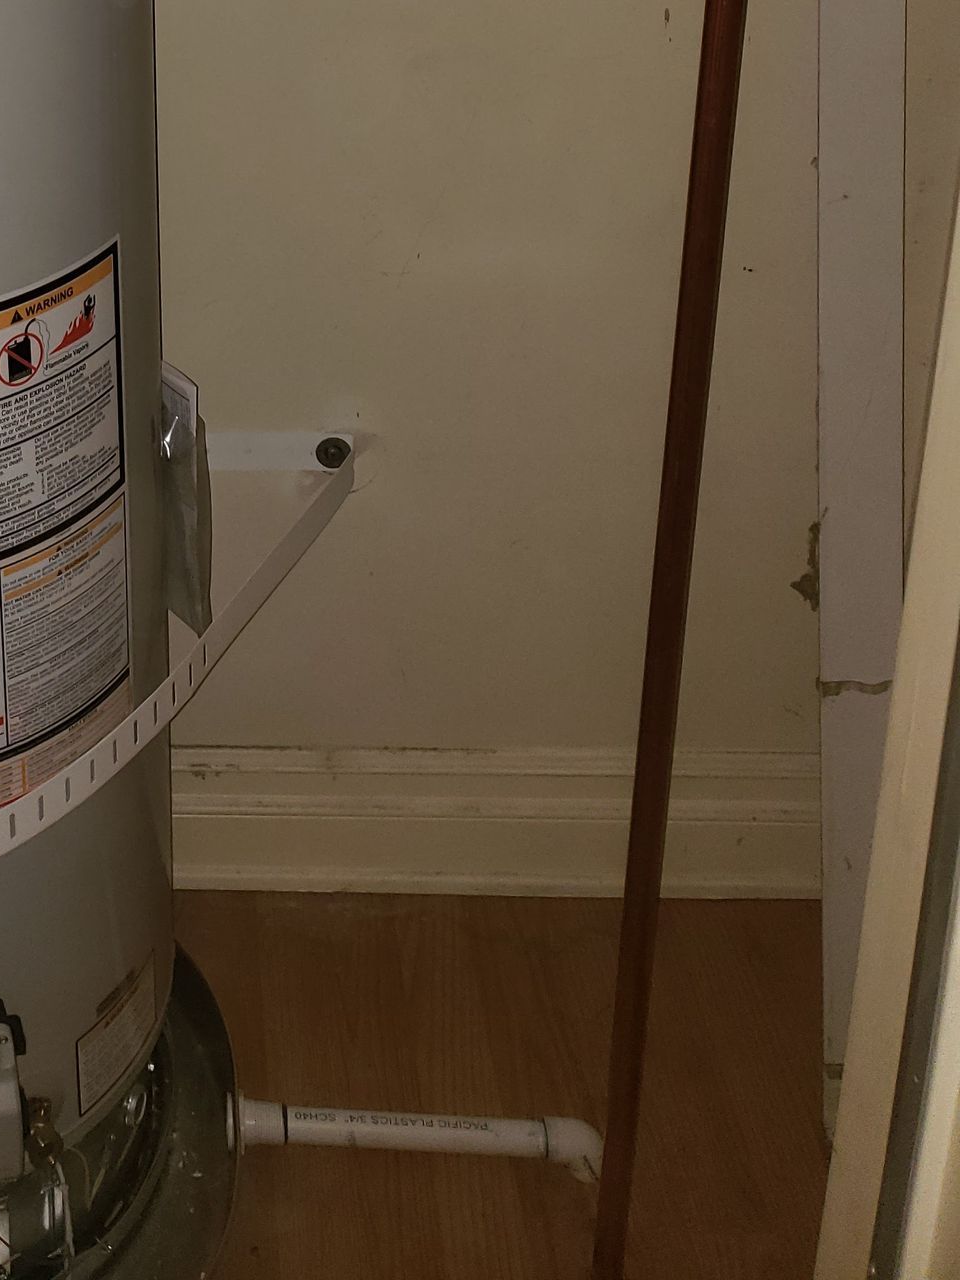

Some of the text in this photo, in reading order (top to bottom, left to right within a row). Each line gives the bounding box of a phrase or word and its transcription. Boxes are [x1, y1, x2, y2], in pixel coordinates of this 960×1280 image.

[25, 286, 74, 318] WARNING
[45, 341, 90, 372] Flammable Vapors
[14, 394, 28, 405] AND
[29, 377, 63, 398] EXPLOSION
[65, 363, 87, 381] HAZARD
[48, 553, 60, 562] FOR
[295, 1111, 337, 1122] SCH40
[372, 1115, 434, 1128] PLASTICS
[440, 1121, 488, 1130] PACIFIC
